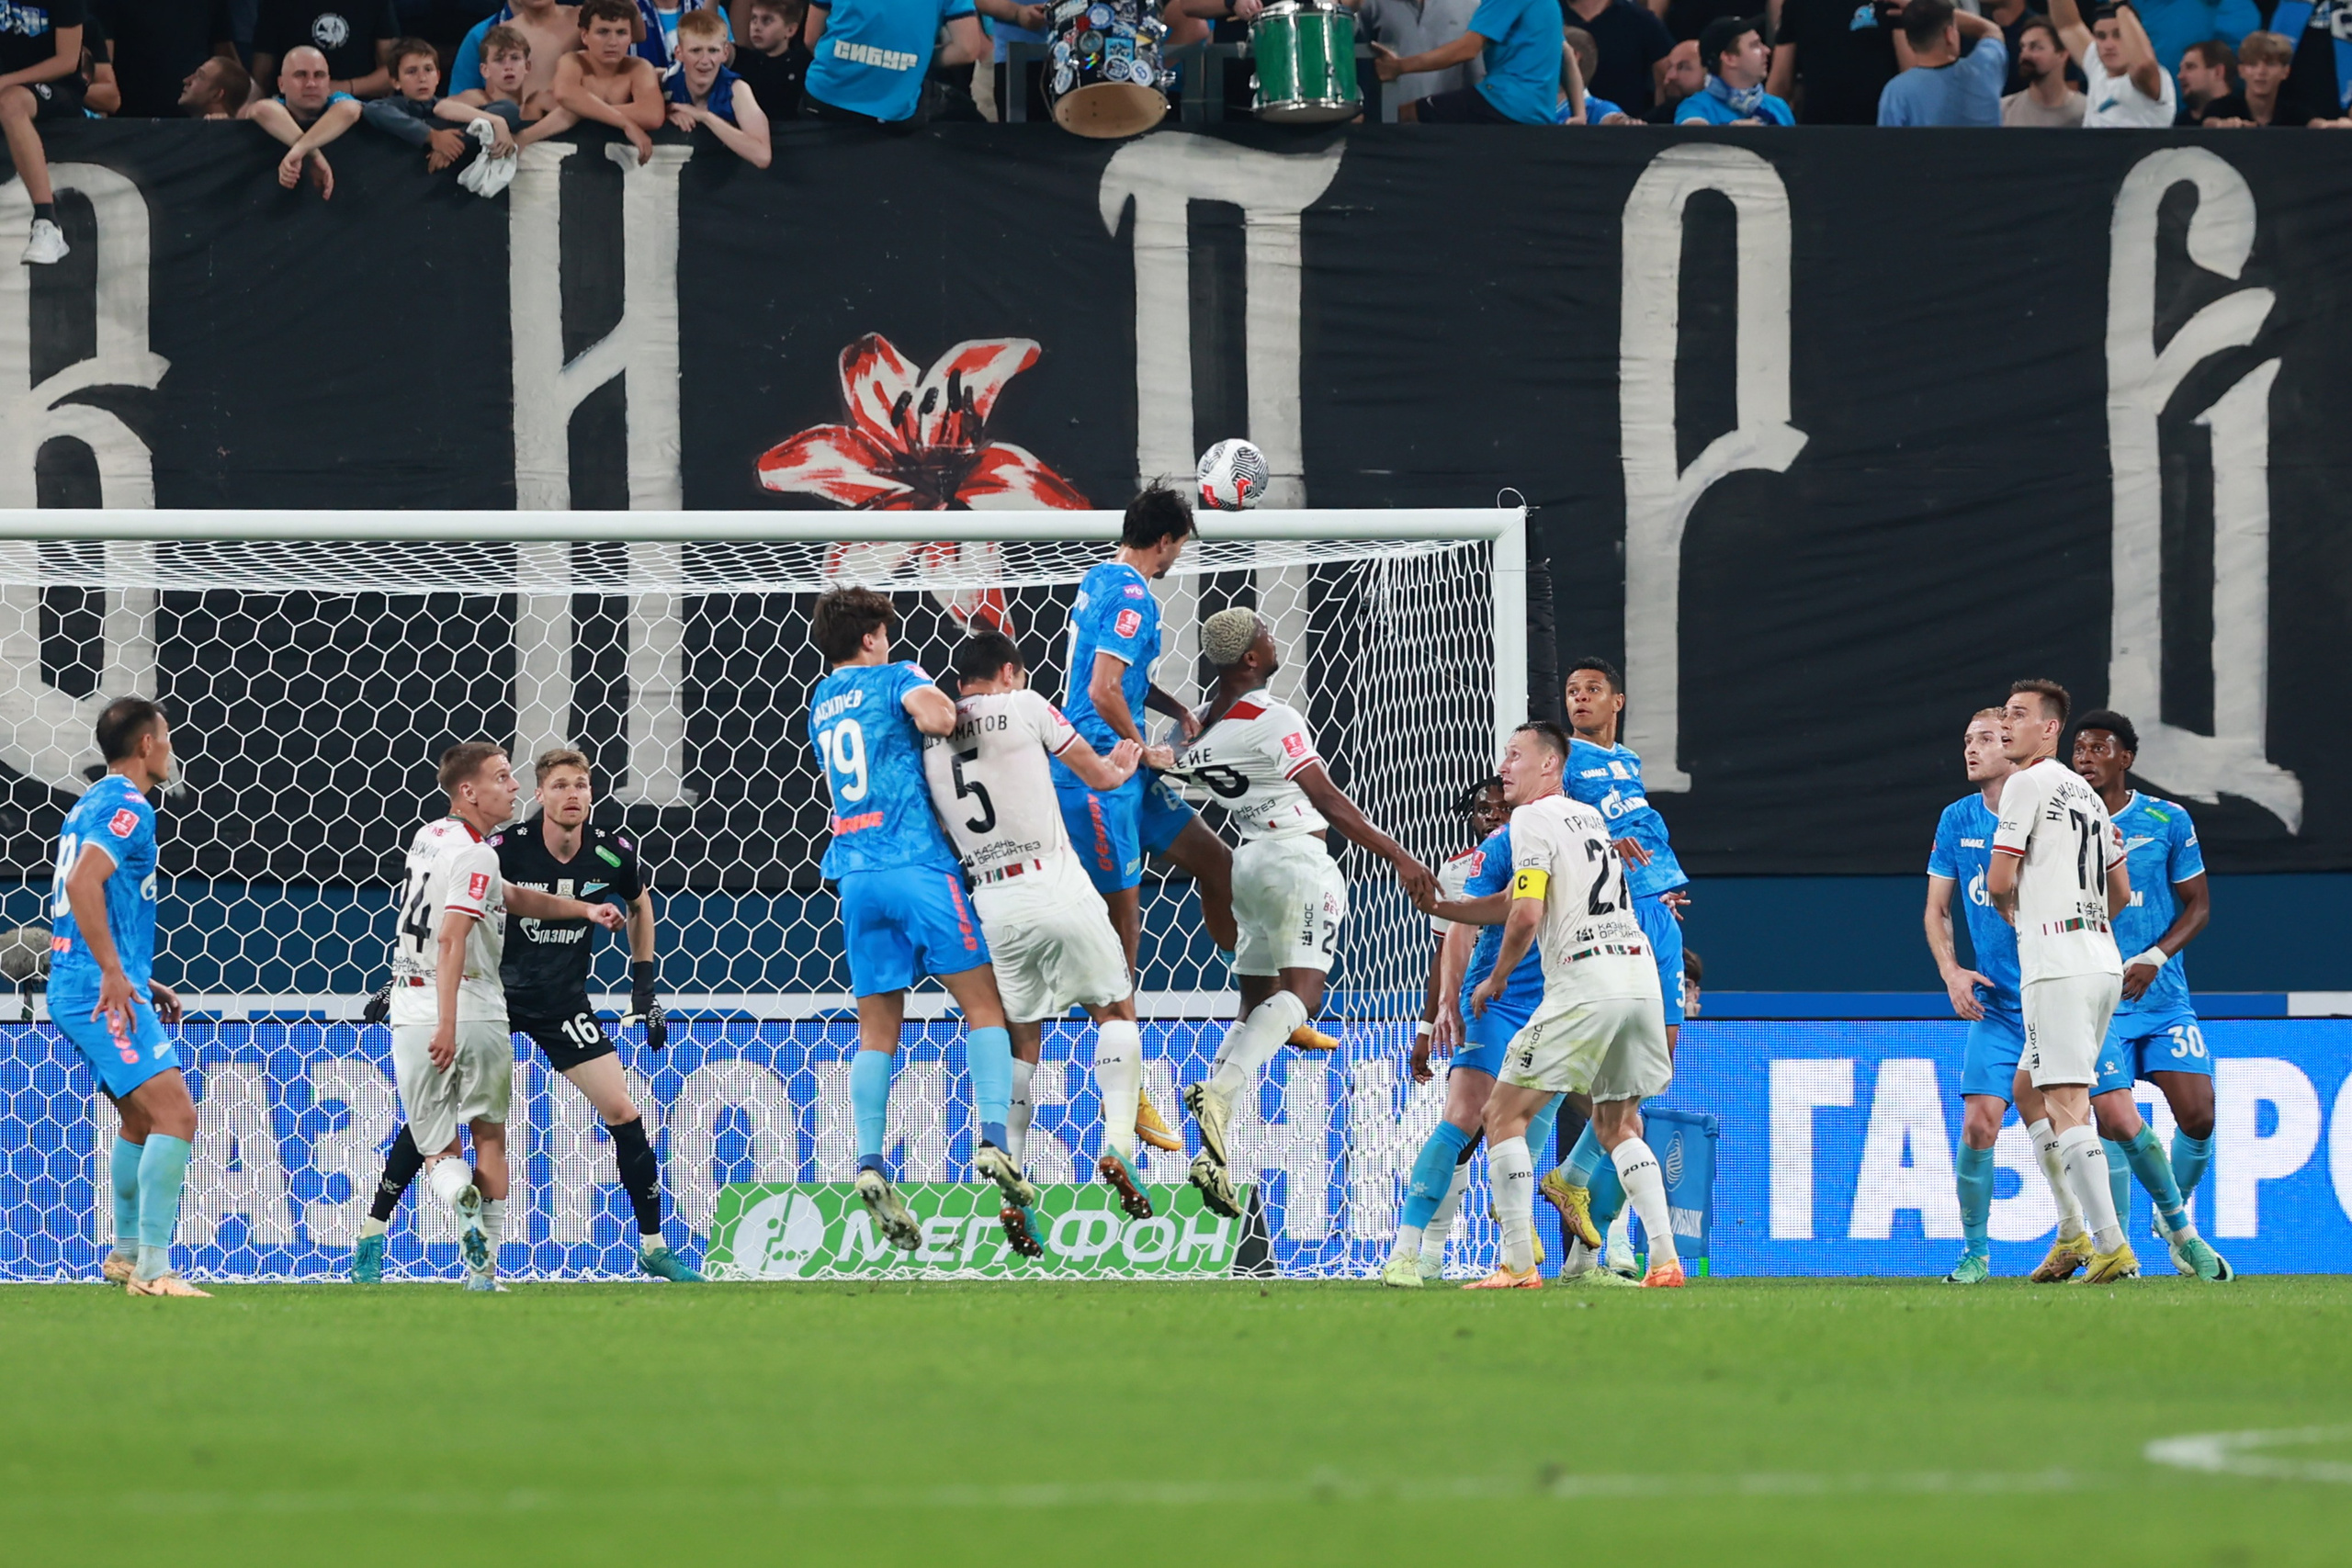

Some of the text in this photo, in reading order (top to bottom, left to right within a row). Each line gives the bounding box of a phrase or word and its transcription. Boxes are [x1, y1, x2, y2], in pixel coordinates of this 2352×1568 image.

[833, 39, 919, 72] СИБУР
[951, 747, 996, 834] 5
[972, 840, 1016, 855] КАЗАНЬ
[978, 840, 1042, 865] ОРГСИНТЕЗ
[2068, 807, 2105, 897] 71
[516, 881, 549, 893] KAMAZ
[560, 1011, 600, 1049] 16
[2167, 1025, 2206, 1058] 30
[838, 1209, 1231, 1263] МЕГФОН
